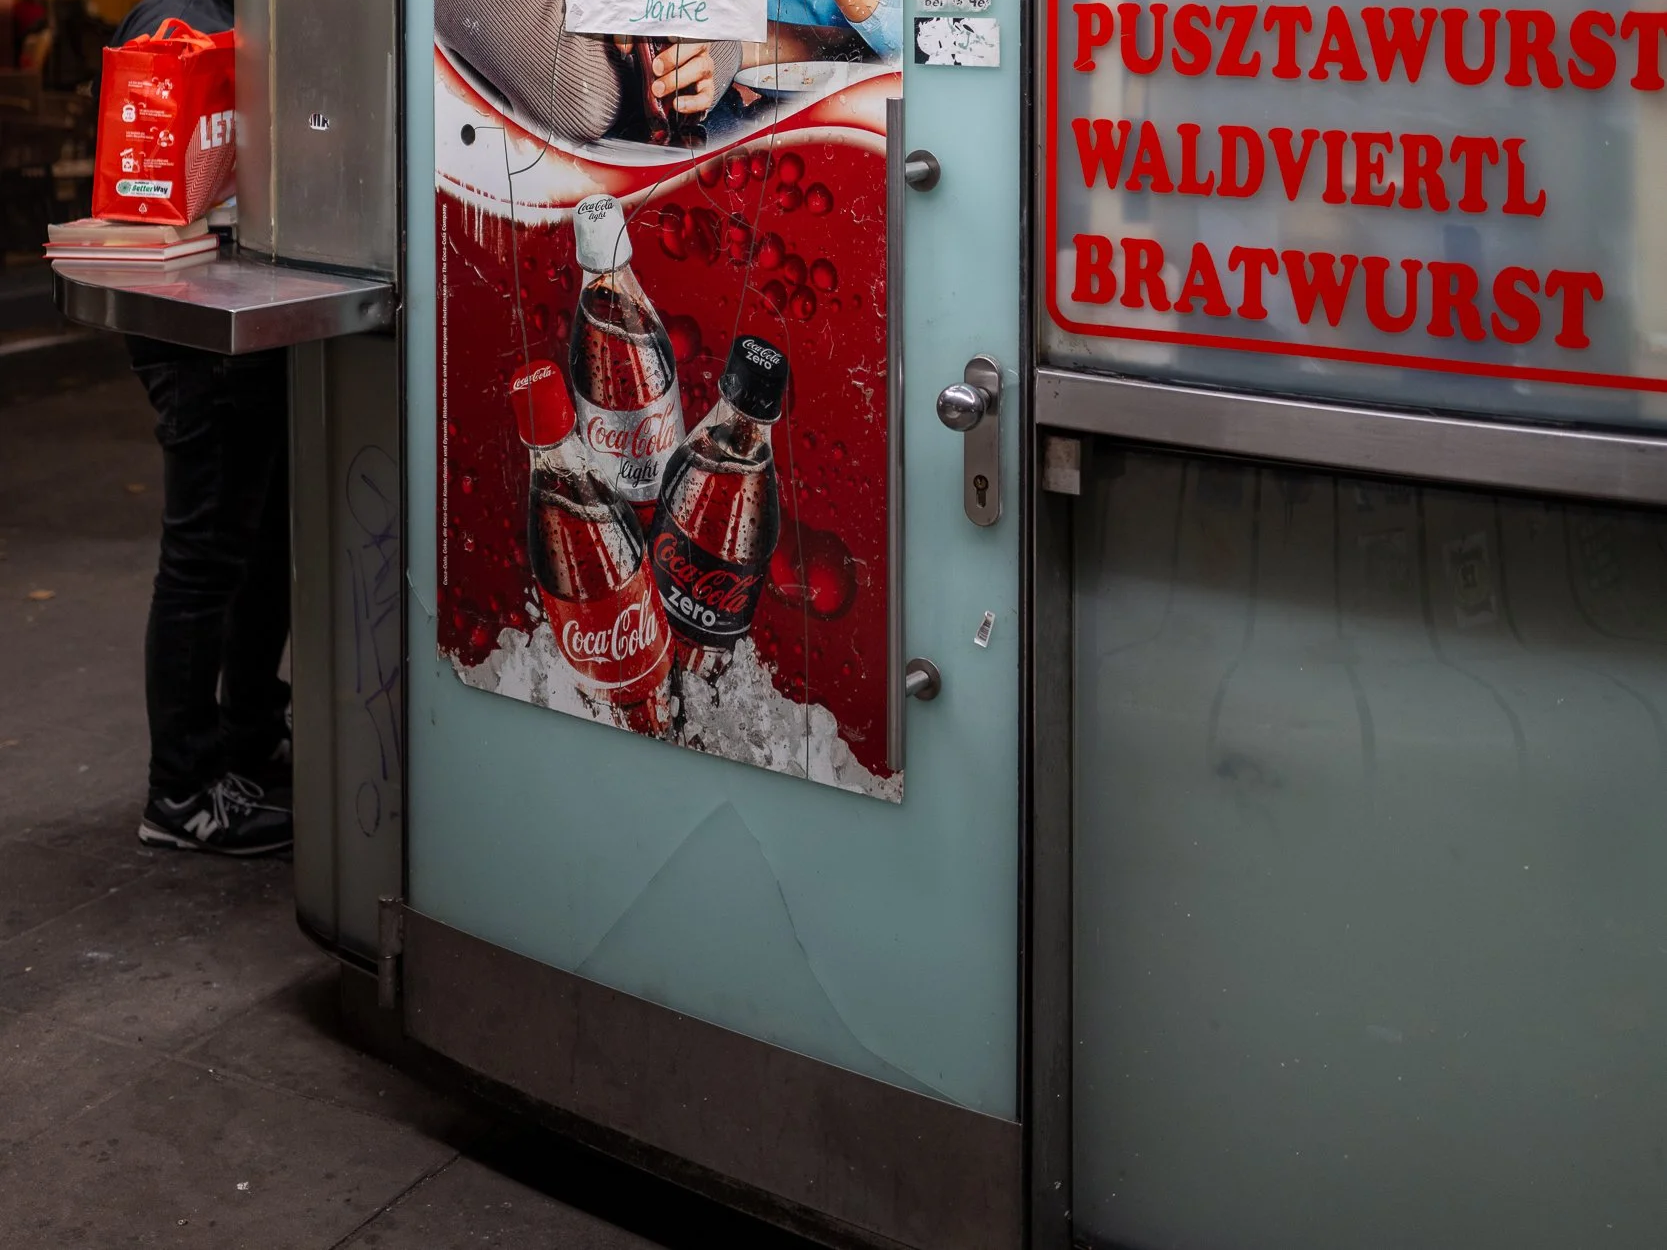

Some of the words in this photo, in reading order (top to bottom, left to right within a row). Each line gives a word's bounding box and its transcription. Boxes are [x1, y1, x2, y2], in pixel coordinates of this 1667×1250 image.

[1073, 2, 1667, 91] PUSZTAWURST
[1072, 118, 1546, 217] WALDVIERTL
[577, 198, 615, 215] Coca-Cola
[588, 211, 606, 223] light
[1071, 233, 1603, 349] BRATWURST
[742, 339, 783, 365] Coca-Cola
[745, 352, 772, 370] zero
[586, 403, 676, 459] Coca-Cola
[620, 459, 660, 487] light
[653, 532, 760, 614] Coca-Cola
[563, 590, 658, 664] Coca-Cola
[667, 586, 717, 627] zero
